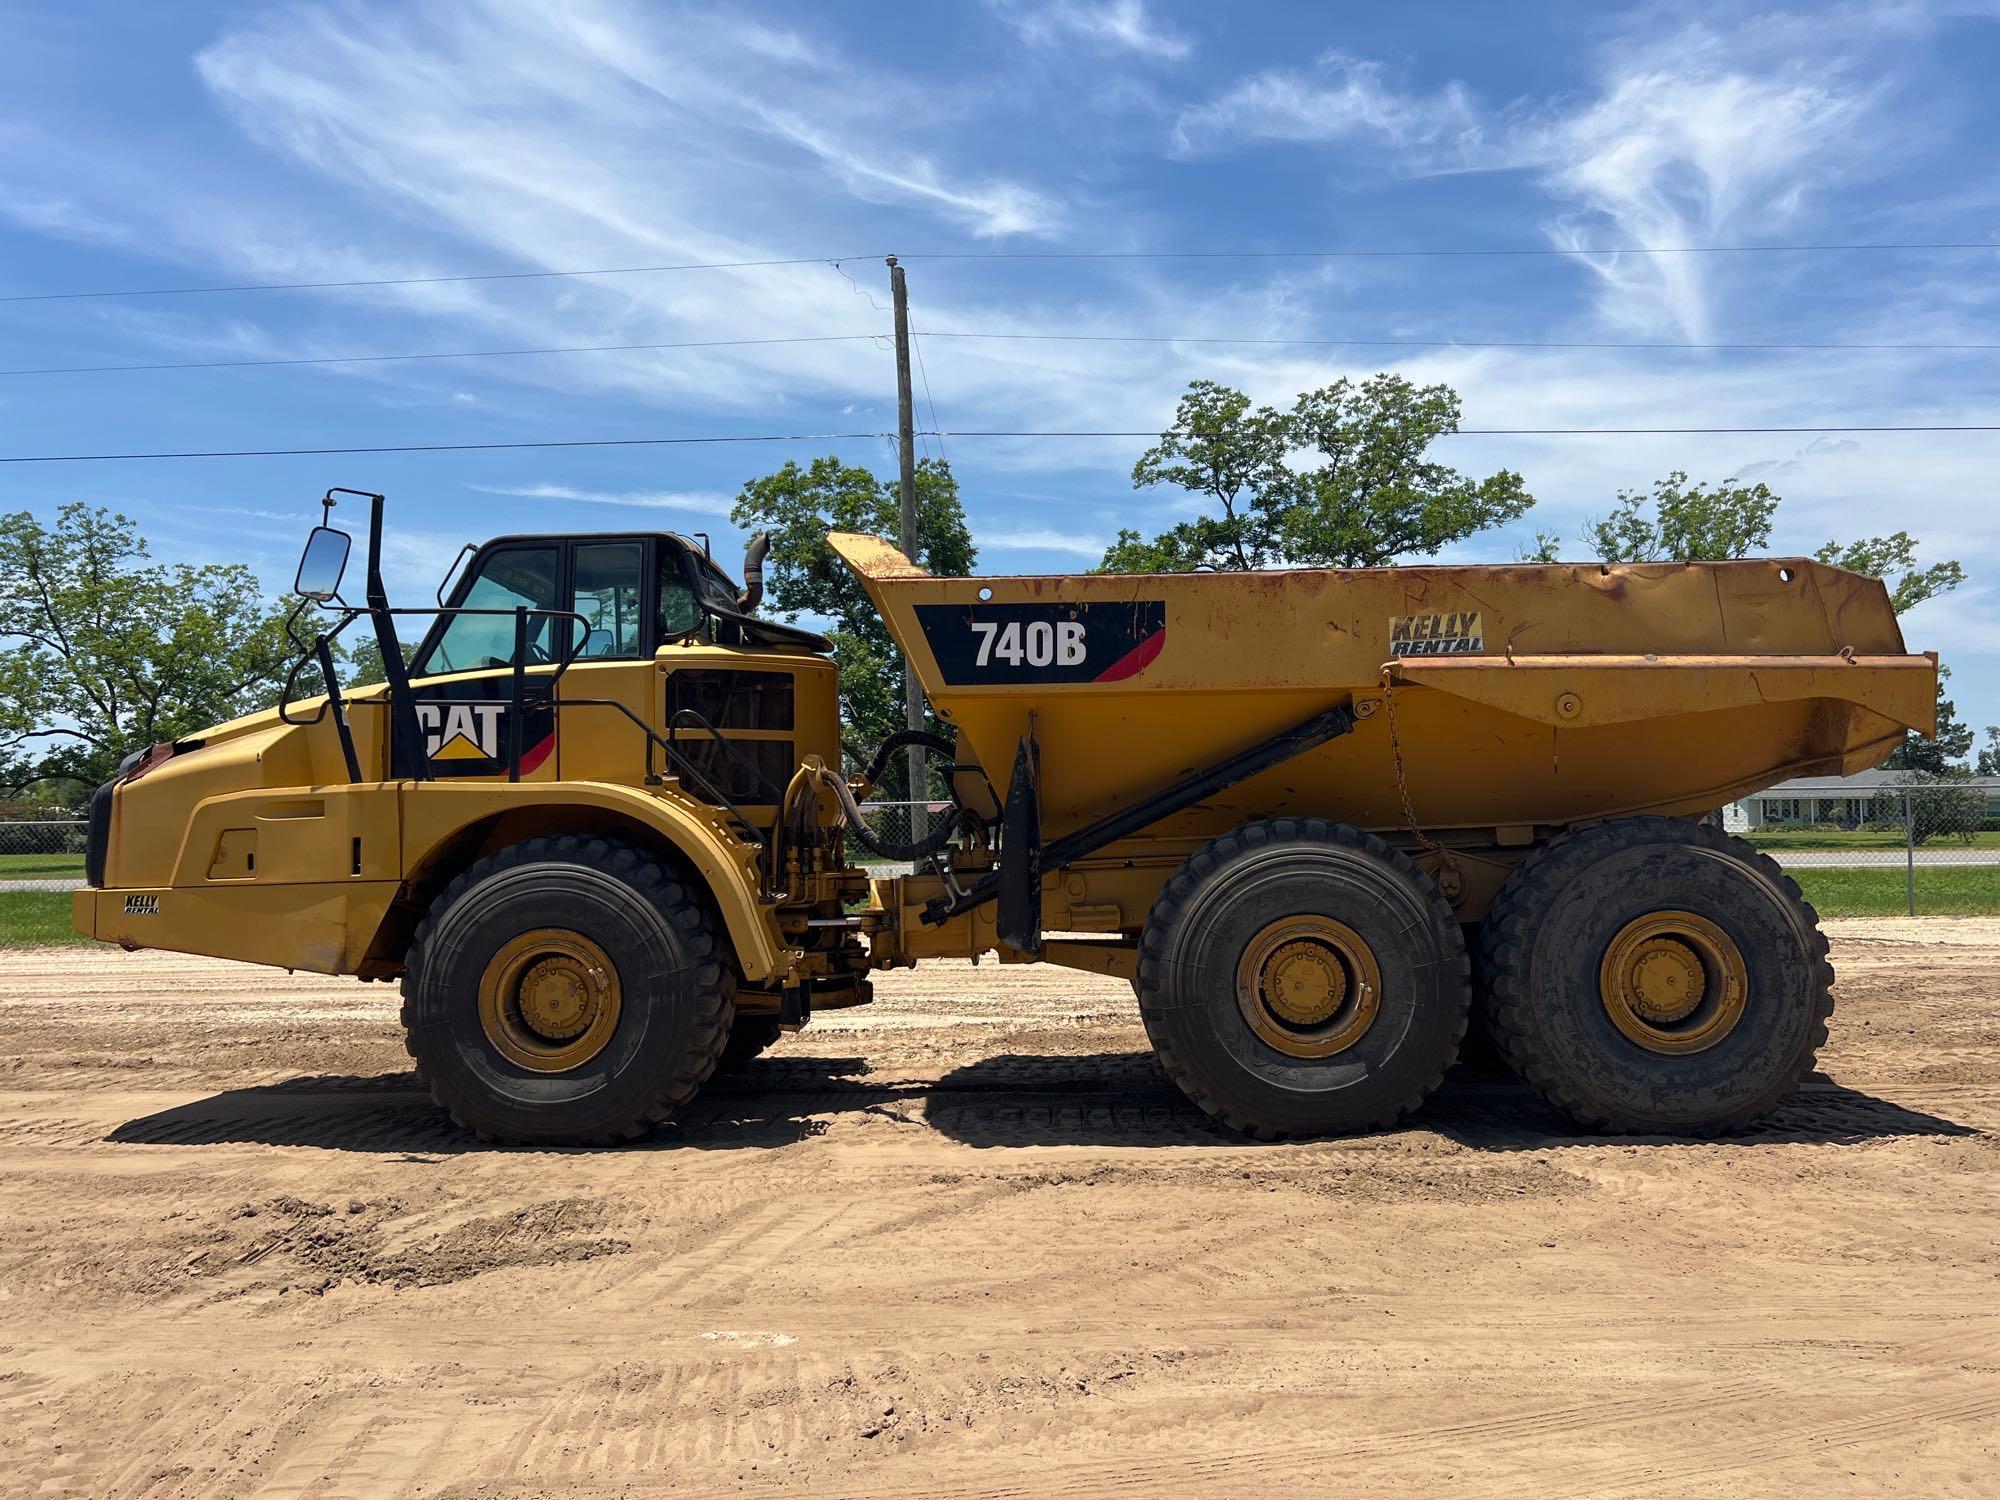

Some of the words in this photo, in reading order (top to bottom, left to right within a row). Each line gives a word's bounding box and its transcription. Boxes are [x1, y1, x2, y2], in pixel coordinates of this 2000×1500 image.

[1391, 612, 1478, 641] KELLY
[971, 621, 1087, 667] 740B
[1391, 637, 1482, 655] RENTAL
[414, 705, 505, 759] CAT
[125, 895, 158, 907] KELLY
